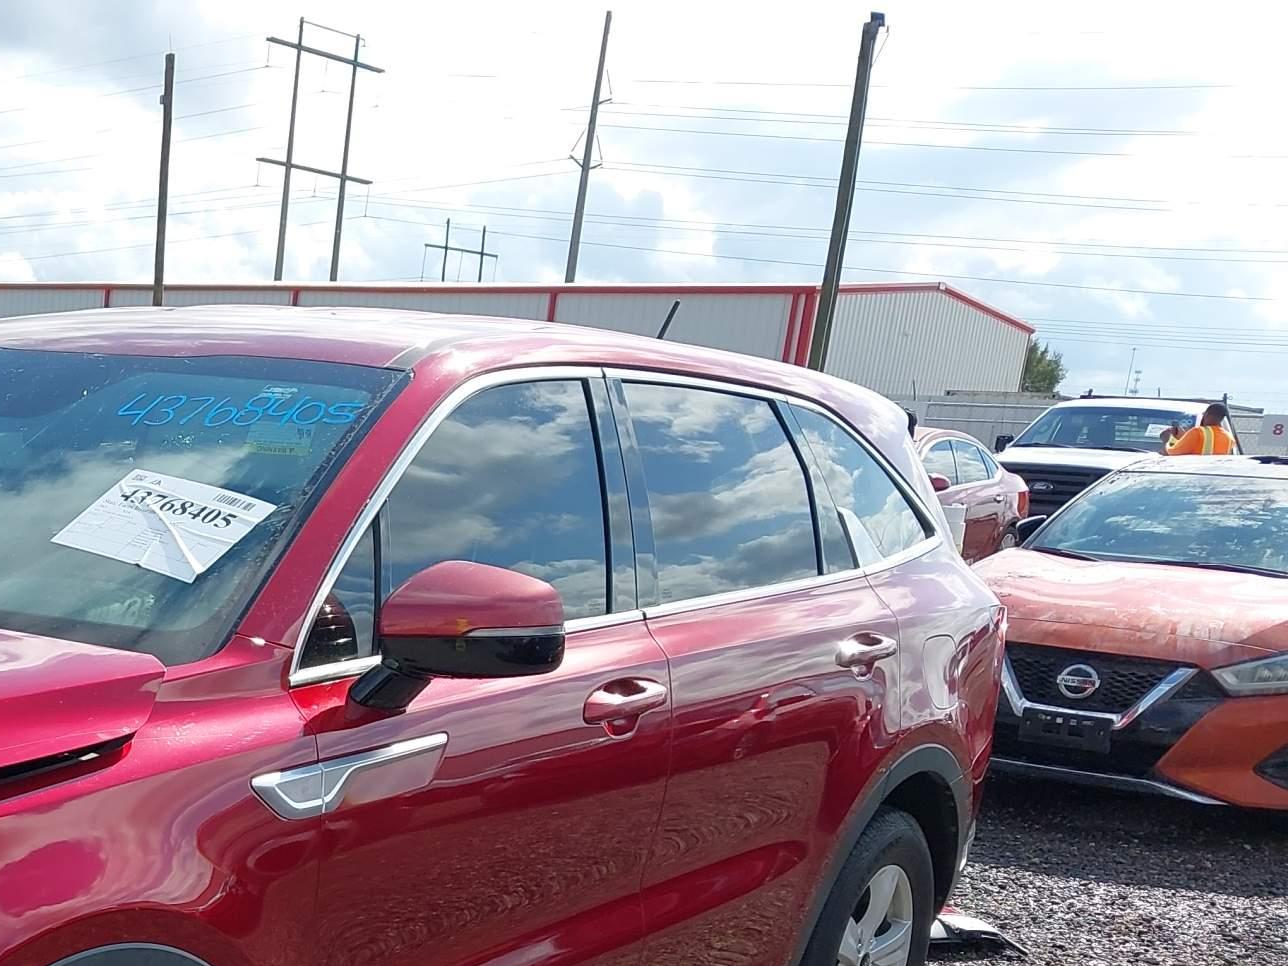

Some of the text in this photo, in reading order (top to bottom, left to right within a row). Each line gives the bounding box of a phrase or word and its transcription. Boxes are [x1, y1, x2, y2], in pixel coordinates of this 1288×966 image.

[117, 393, 362, 427] 43768405
[1273, 424, 1284, 436] 8
[120, 488, 238, 529] 43768405
